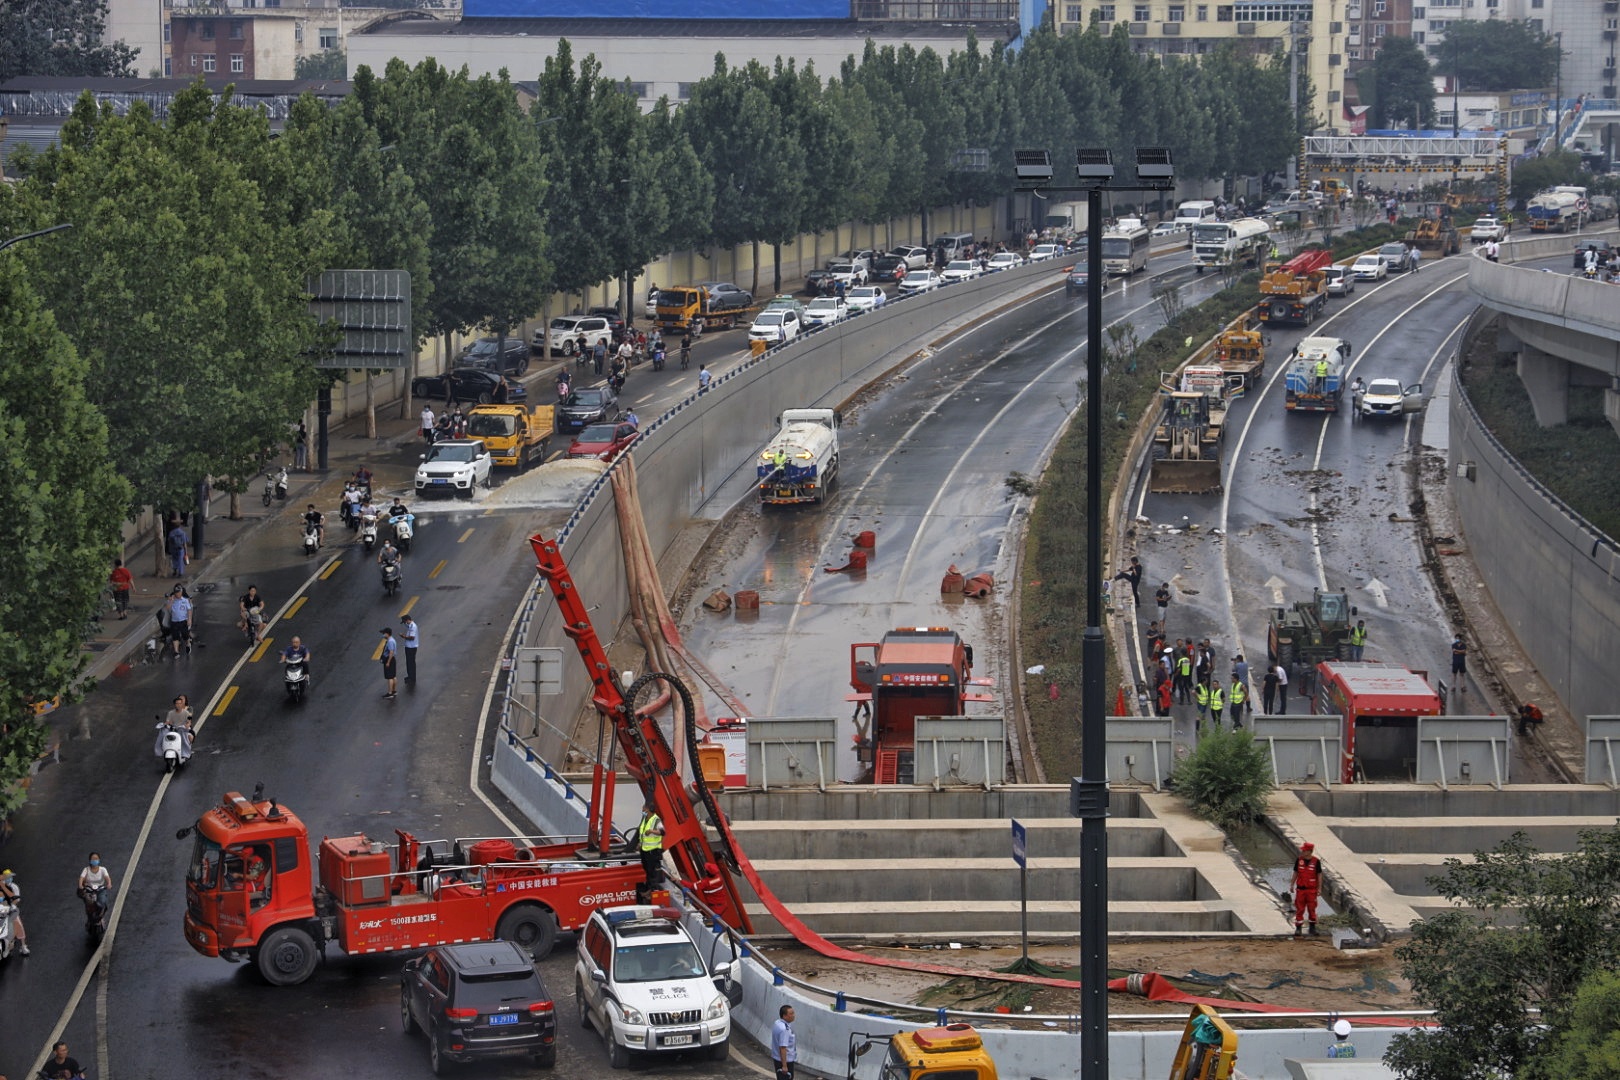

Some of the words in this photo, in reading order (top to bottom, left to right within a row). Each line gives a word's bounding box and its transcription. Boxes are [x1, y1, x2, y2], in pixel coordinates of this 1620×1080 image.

[509, 877, 558, 891] 中国安能救援
[595, 892, 614, 900] QIAO
[615, 889, 637, 898] LONG
[652, 993, 690, 1001] POLICE
